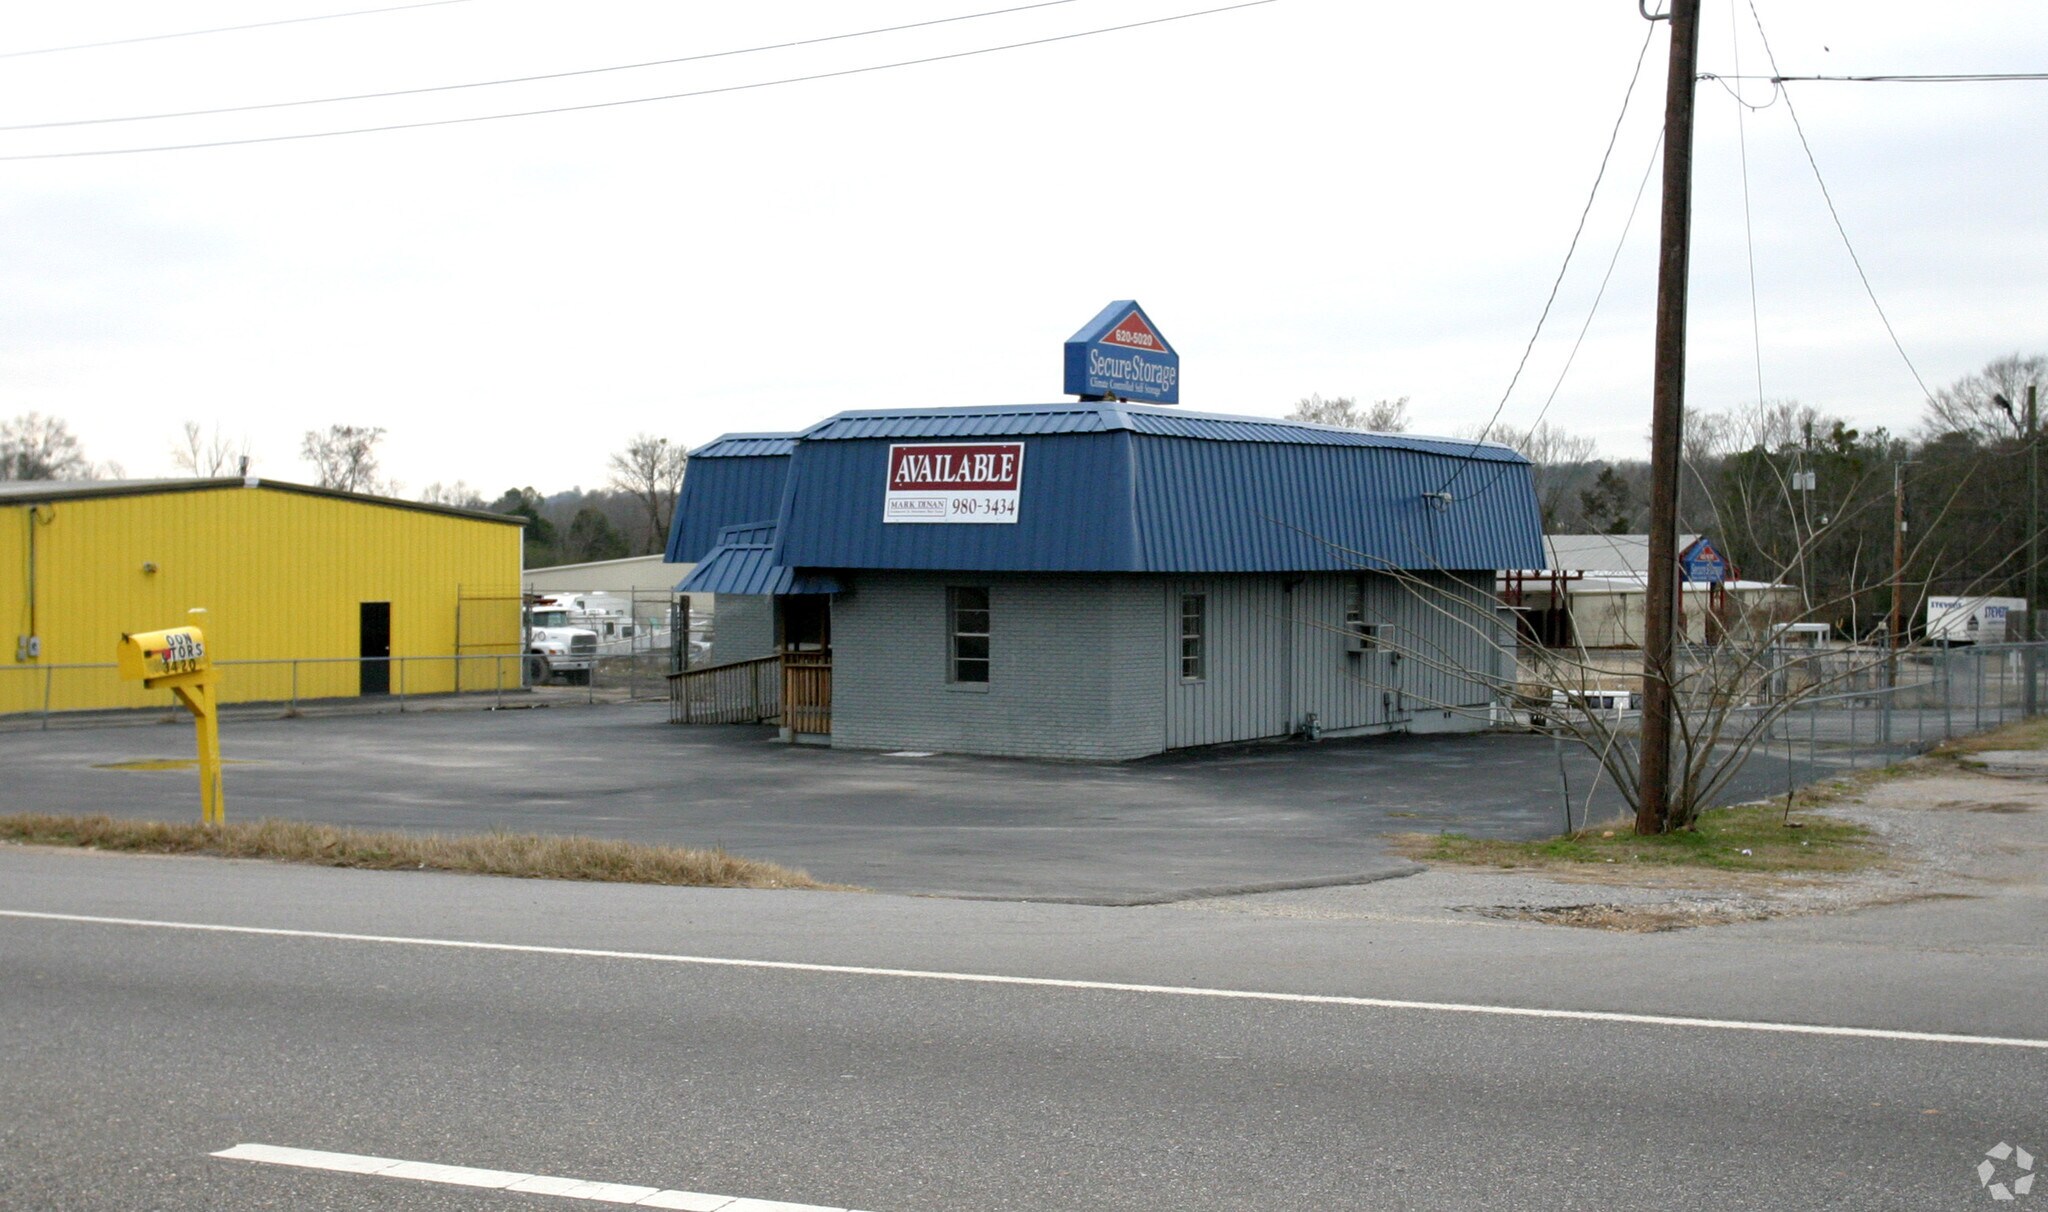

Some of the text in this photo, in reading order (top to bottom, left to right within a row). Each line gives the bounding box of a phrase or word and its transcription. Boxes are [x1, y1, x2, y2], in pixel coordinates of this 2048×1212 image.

[1115, 329, 1153, 346] 620-5020
[894, 453, 1014, 483] AVAILABLE
[890, 501, 914, 509] MARK
[952, 498, 1015, 515] 980-3434
